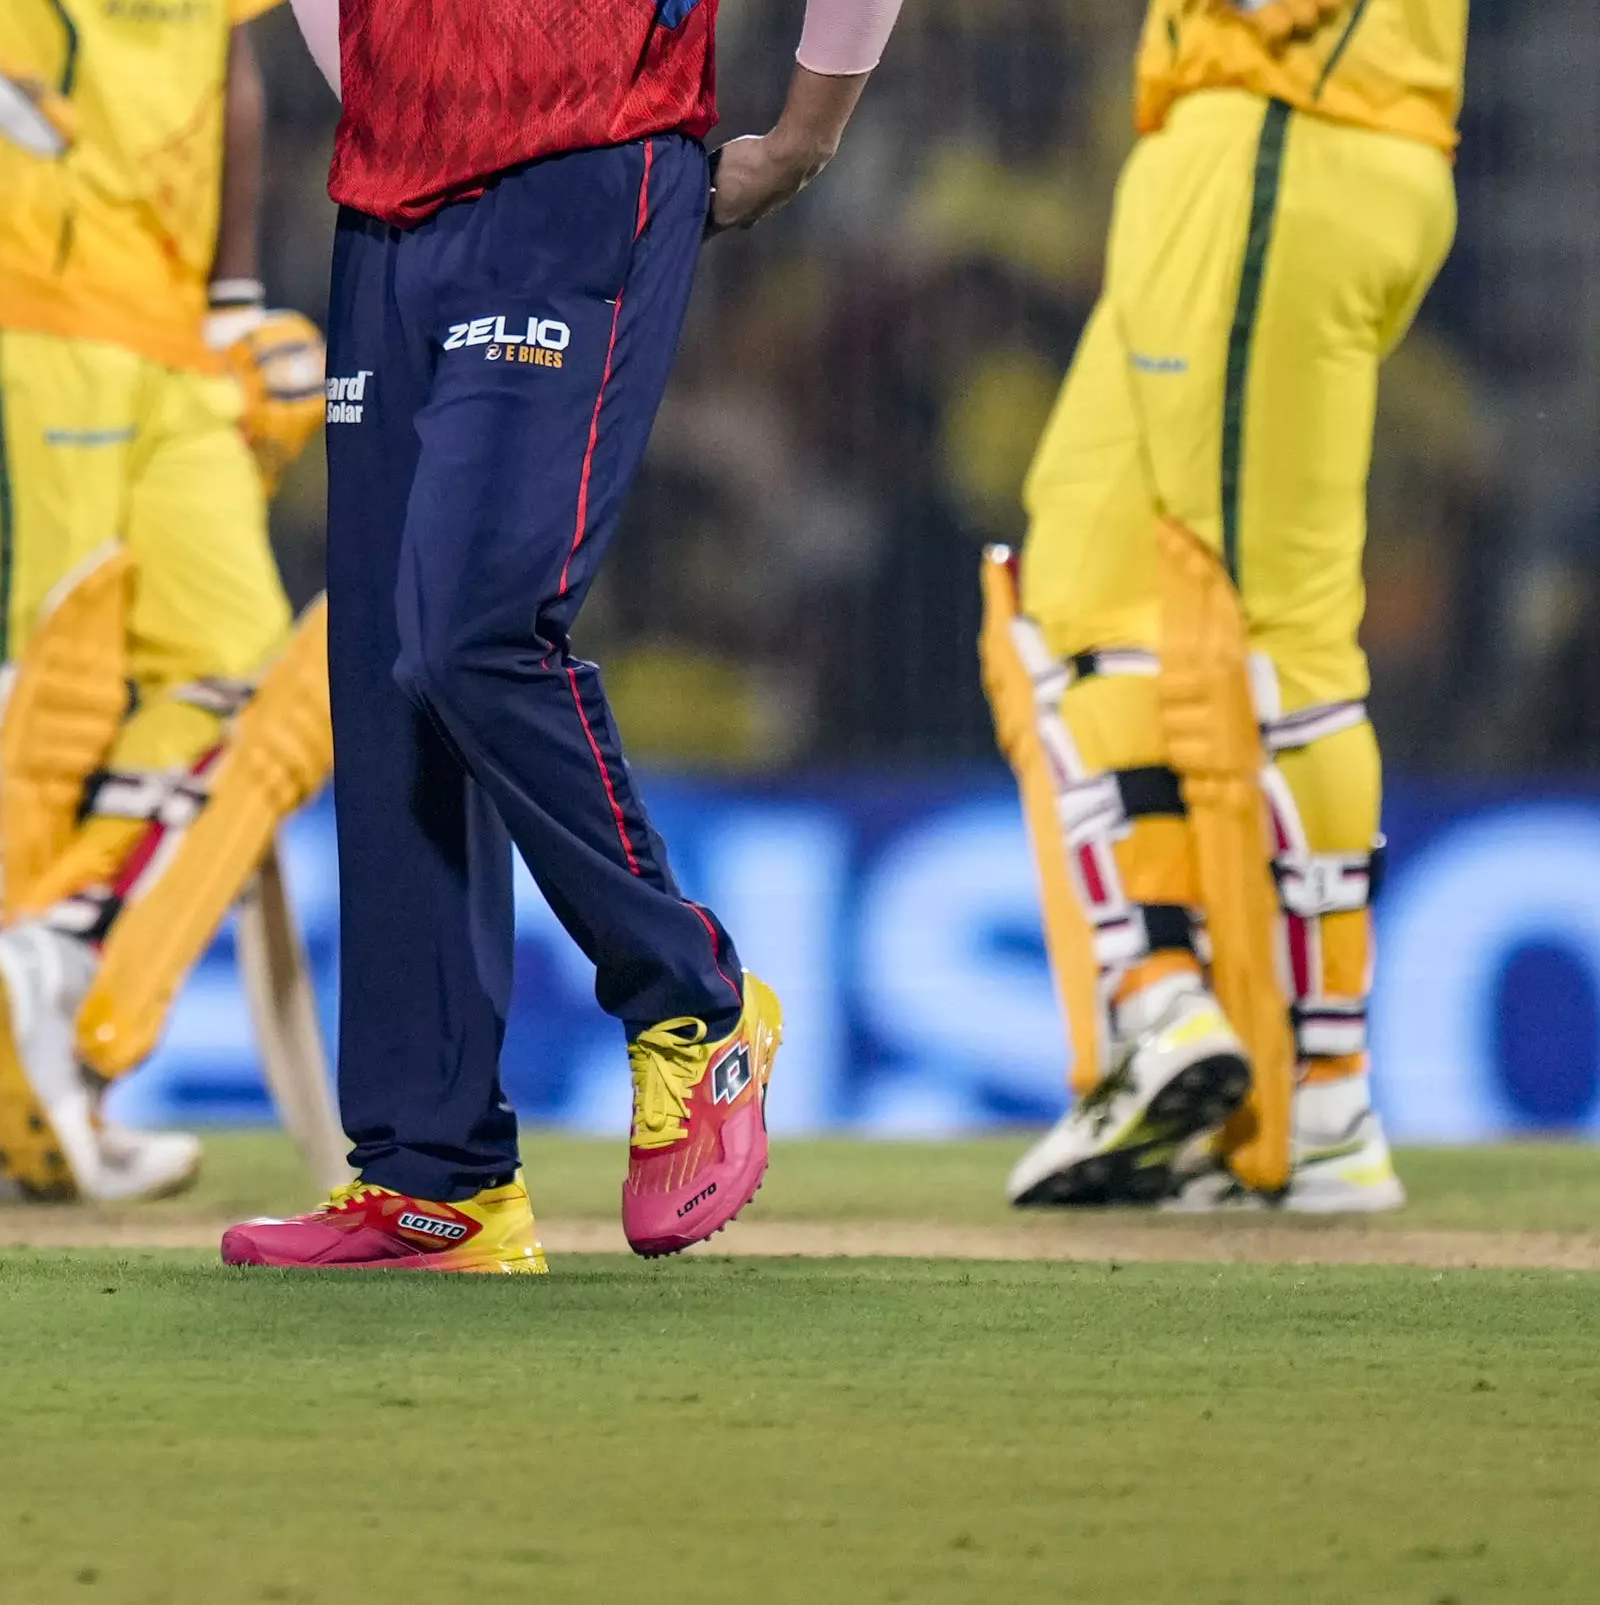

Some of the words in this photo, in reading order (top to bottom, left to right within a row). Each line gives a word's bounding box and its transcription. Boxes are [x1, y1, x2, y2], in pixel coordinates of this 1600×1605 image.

[443, 315, 571, 351] ZELIO
[505, 345, 515, 362] E
[518, 347, 563, 369] BIKES
[676, 1182, 717, 1218] LOTTO
[400, 1213, 466, 1240] LOTTO
